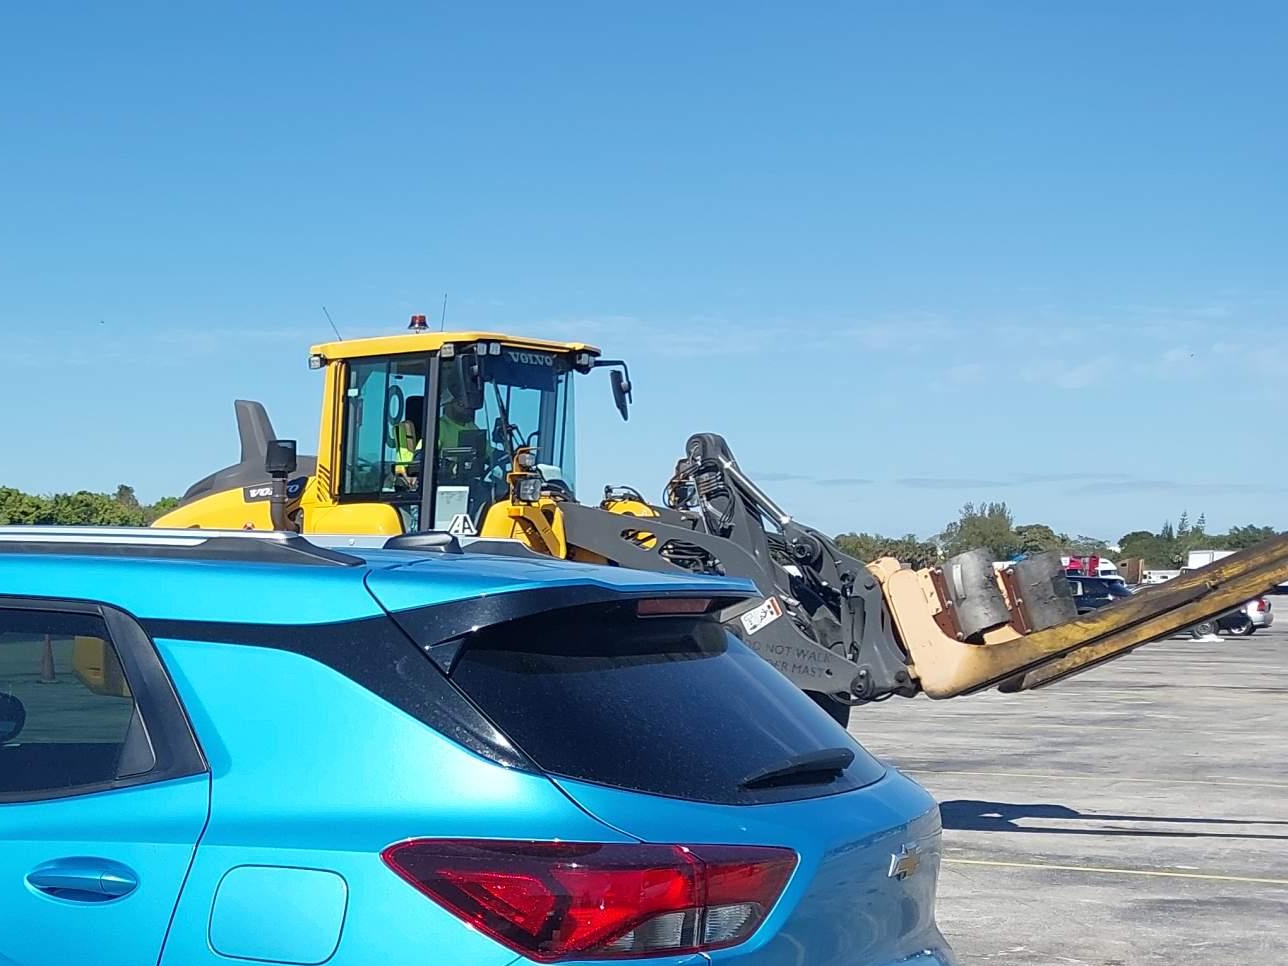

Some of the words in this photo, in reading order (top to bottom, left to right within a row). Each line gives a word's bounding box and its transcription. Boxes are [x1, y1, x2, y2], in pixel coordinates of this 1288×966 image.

[508, 351, 553, 367] VOLVO
[249, 484, 300, 498] VOO
[766, 643, 793, 657] NOT
[792, 663, 825, 678] MAST
